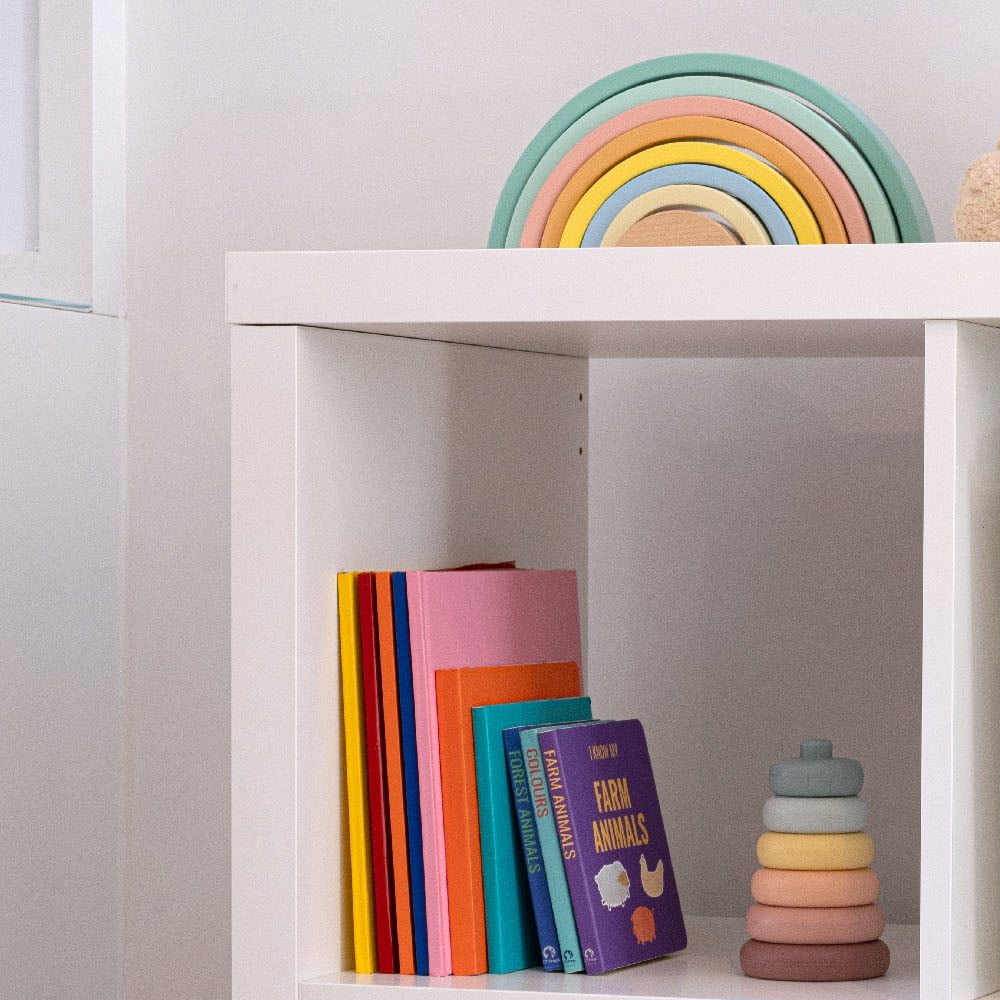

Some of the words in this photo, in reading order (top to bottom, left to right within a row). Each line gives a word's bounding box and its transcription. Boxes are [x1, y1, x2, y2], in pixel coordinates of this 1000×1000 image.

[526, 748, 549, 818] COLOURS
[543, 749, 563, 790] FARM
[593, 777, 632, 813] FARM
[508, 749, 529, 802] FOREST
[520, 809, 541, 874] ANIMALS
[552, 795, 576, 861] ANIMALS
[592, 812, 649, 854] ANIMALS
